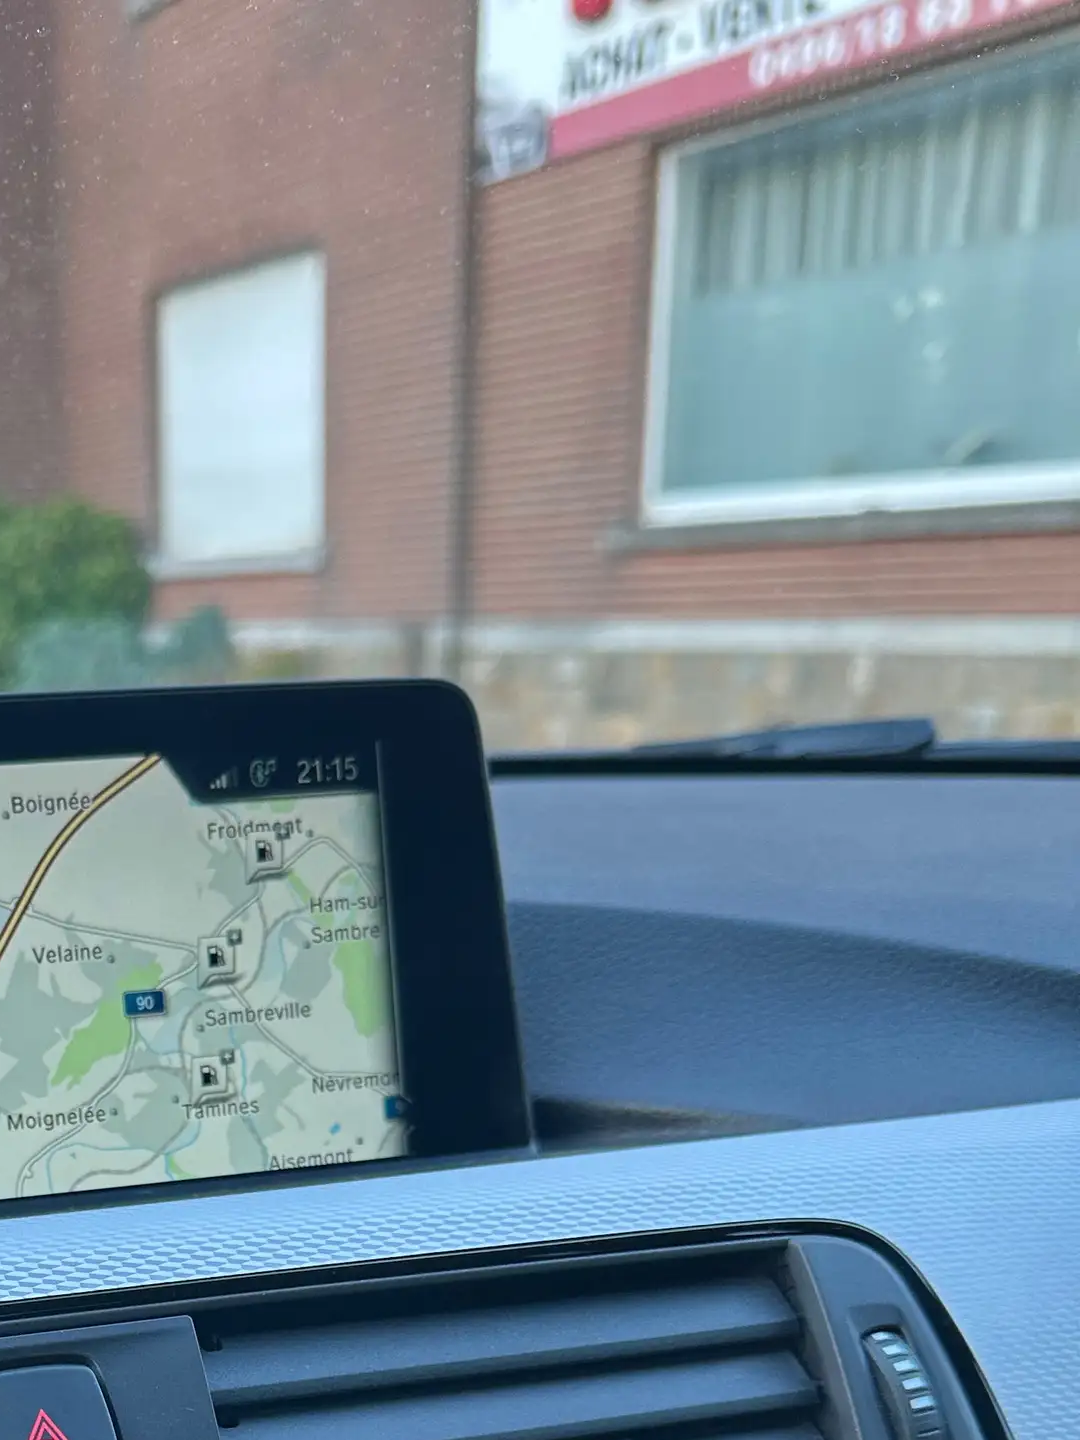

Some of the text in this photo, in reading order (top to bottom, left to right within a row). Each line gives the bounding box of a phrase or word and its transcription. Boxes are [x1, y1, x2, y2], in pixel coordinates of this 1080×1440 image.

[296, 757, 359, 784] 21:15
[11, 791, 91, 815] Boignée
[310, 923, 381, 944] Sambre
[32, 943, 103, 964] Velaine
[136, 995, 153, 1011] 90
[205, 1002, 311, 1027] Sambreville
[7, 1106, 107, 1133] Moignelée
[184, 1097, 260, 1120] Tamines
